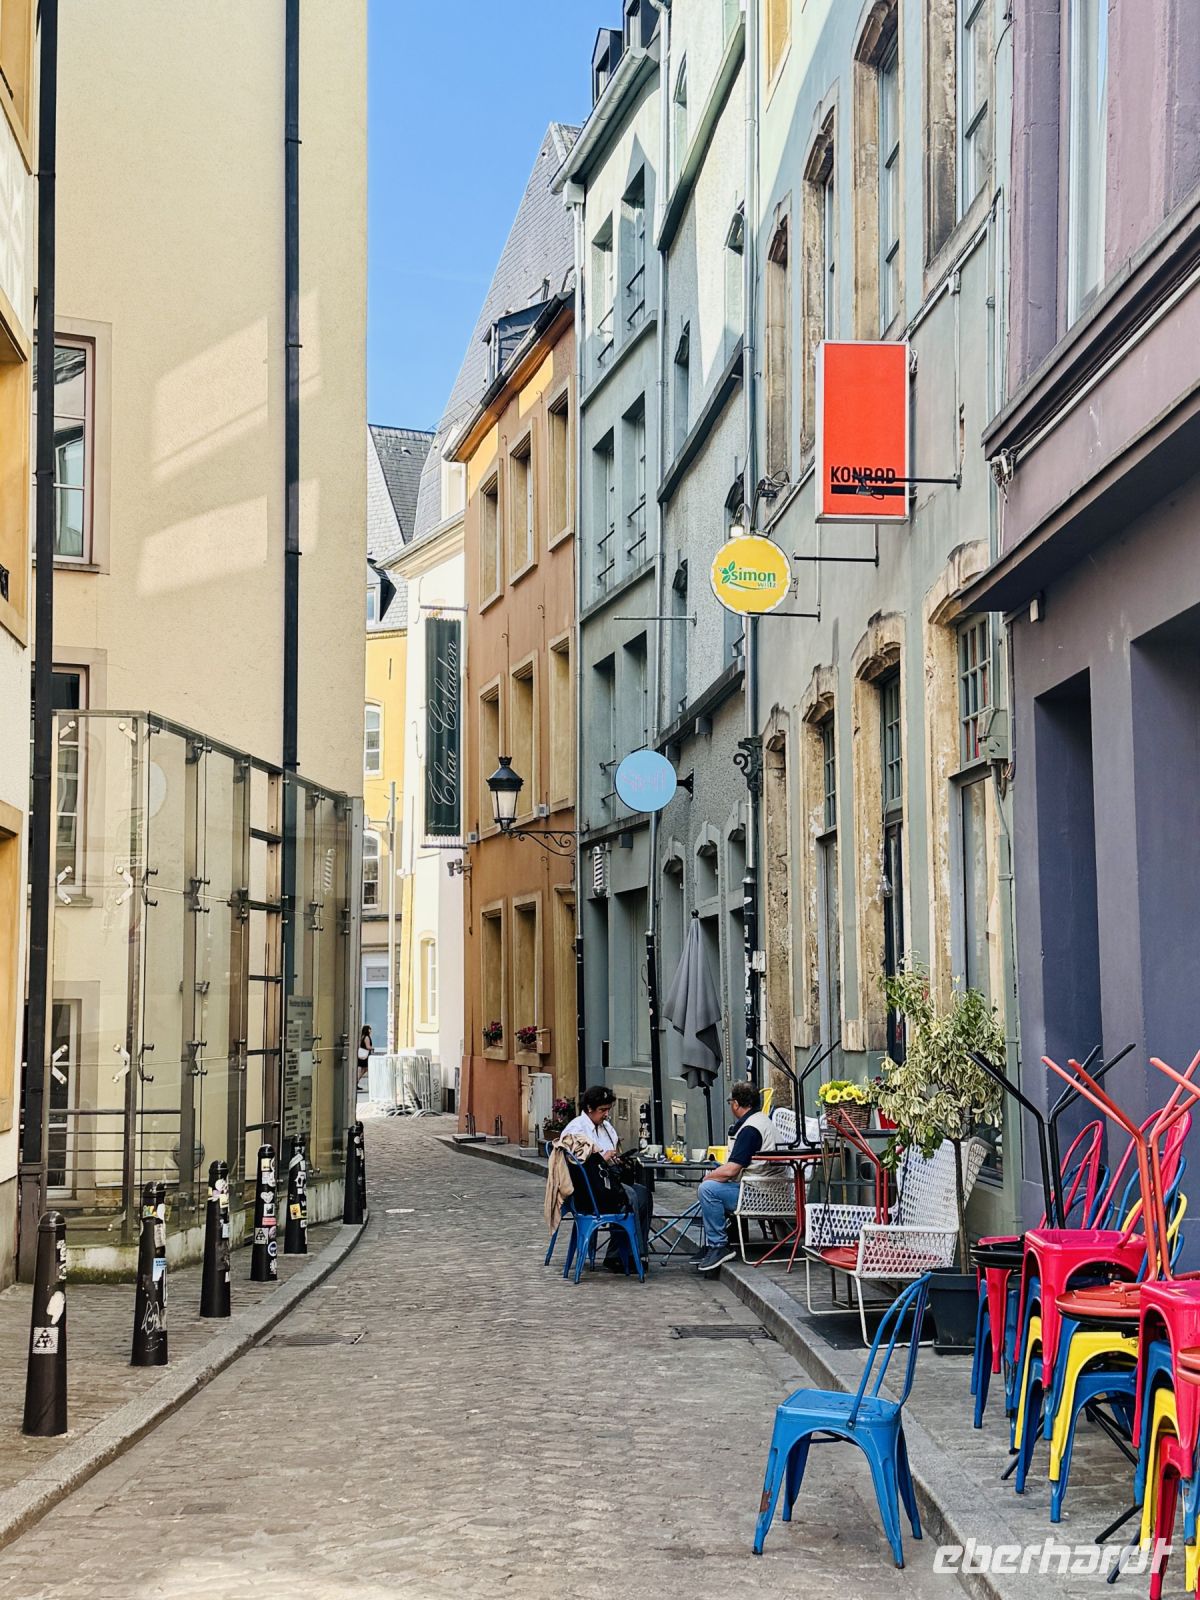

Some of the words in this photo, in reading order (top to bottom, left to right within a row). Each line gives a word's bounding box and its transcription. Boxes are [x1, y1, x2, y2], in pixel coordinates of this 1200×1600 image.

[830, 466, 896, 484] KONRAD
[731, 567, 776, 582] simon
[428, 640, 458, 735] Céladon
